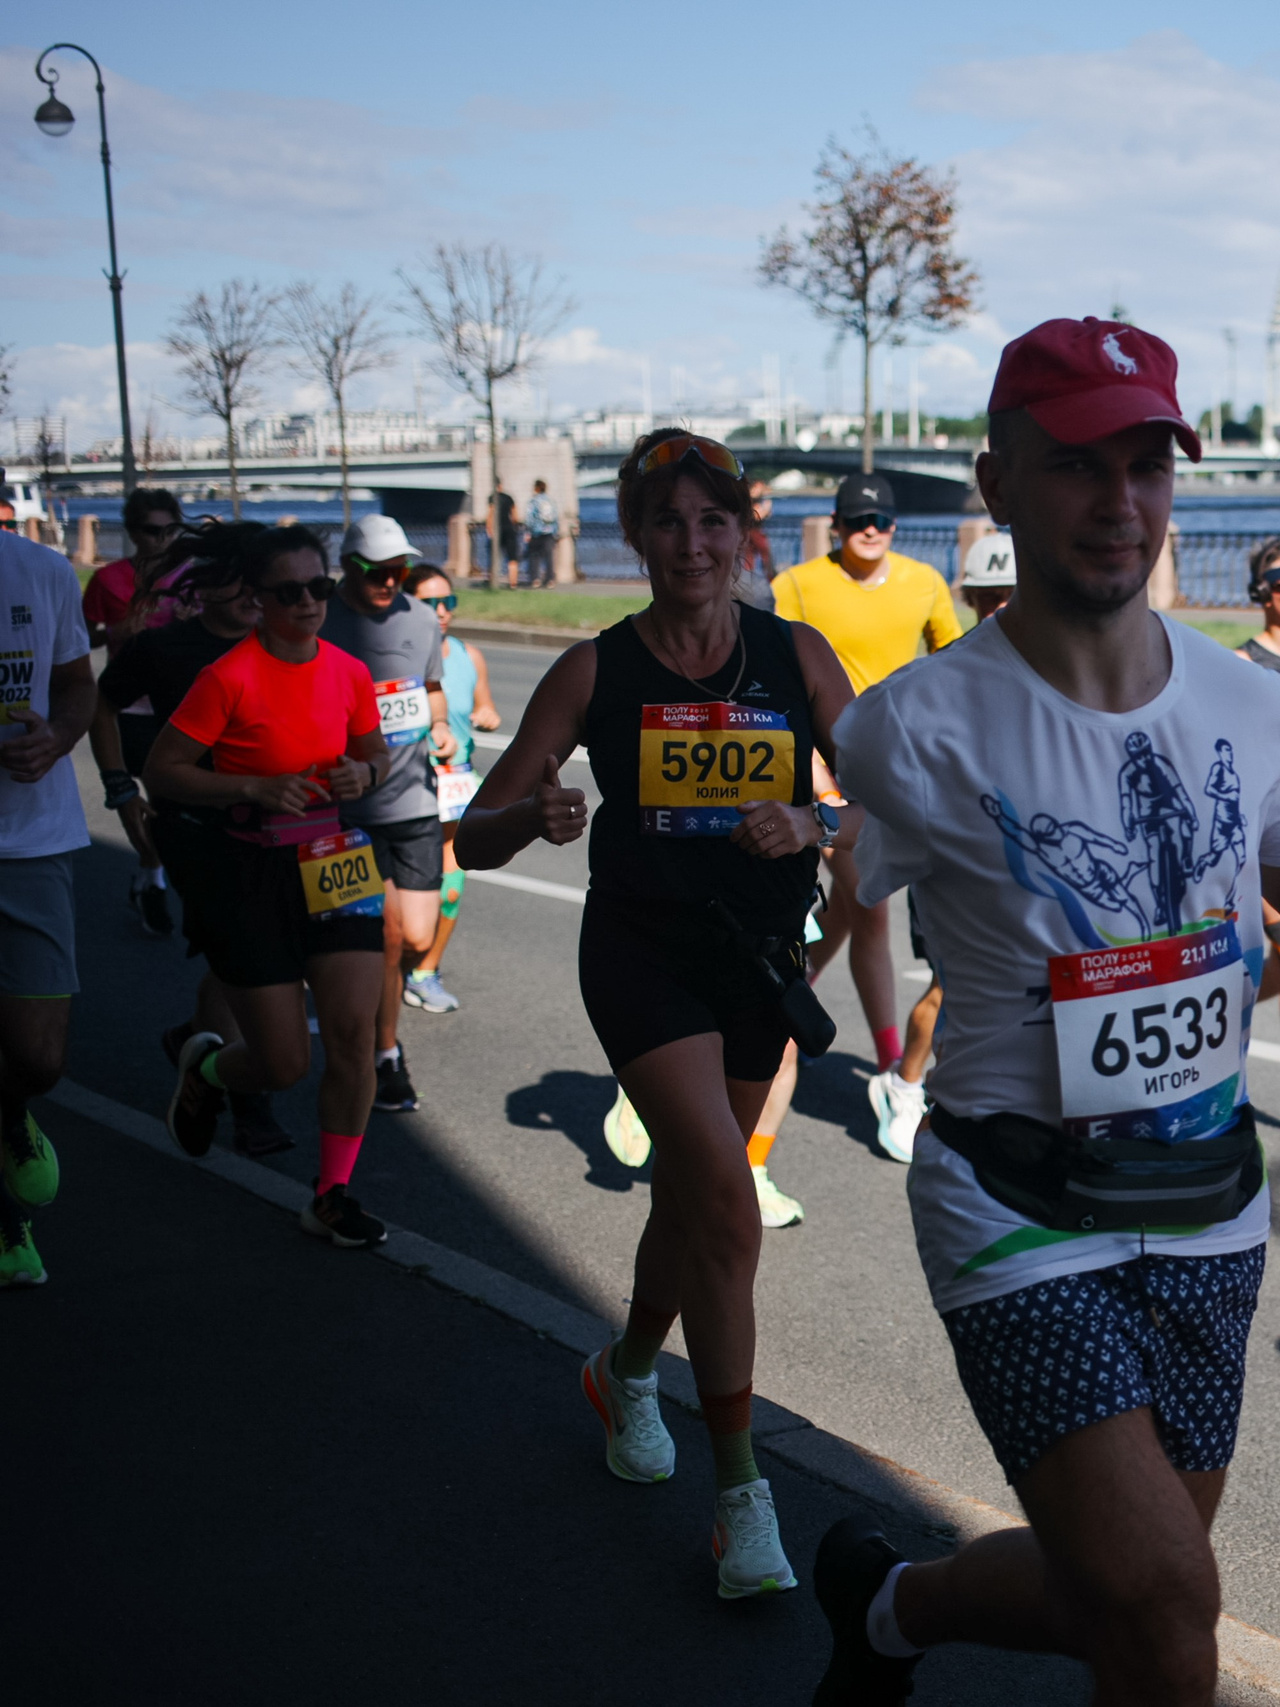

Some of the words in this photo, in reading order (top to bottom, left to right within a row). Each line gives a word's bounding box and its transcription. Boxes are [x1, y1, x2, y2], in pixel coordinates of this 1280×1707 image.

[11, 614, 32, 625] STAR
[0, 687, 32, 703] 2022
[663, 706, 689, 715] ПОЛУ
[663, 714, 710, 722] МАРАФОН
[728, 712, 750, 724] 21,1
[661, 741, 775, 783] 5902
[696, 787, 739, 799] ЮЛИЯ
[656, 810, 672, 831] E
[318, 855, 370, 893] 6020
[1081, 951, 1120, 969] ПОЛУ
[1181, 944, 1207, 965] 21,1
[1083, 960, 1152, 982] МАРАФОН
[1091, 987, 1228, 1077] 6533
[1144, 1066, 1200, 1095] ИГОРЬ
